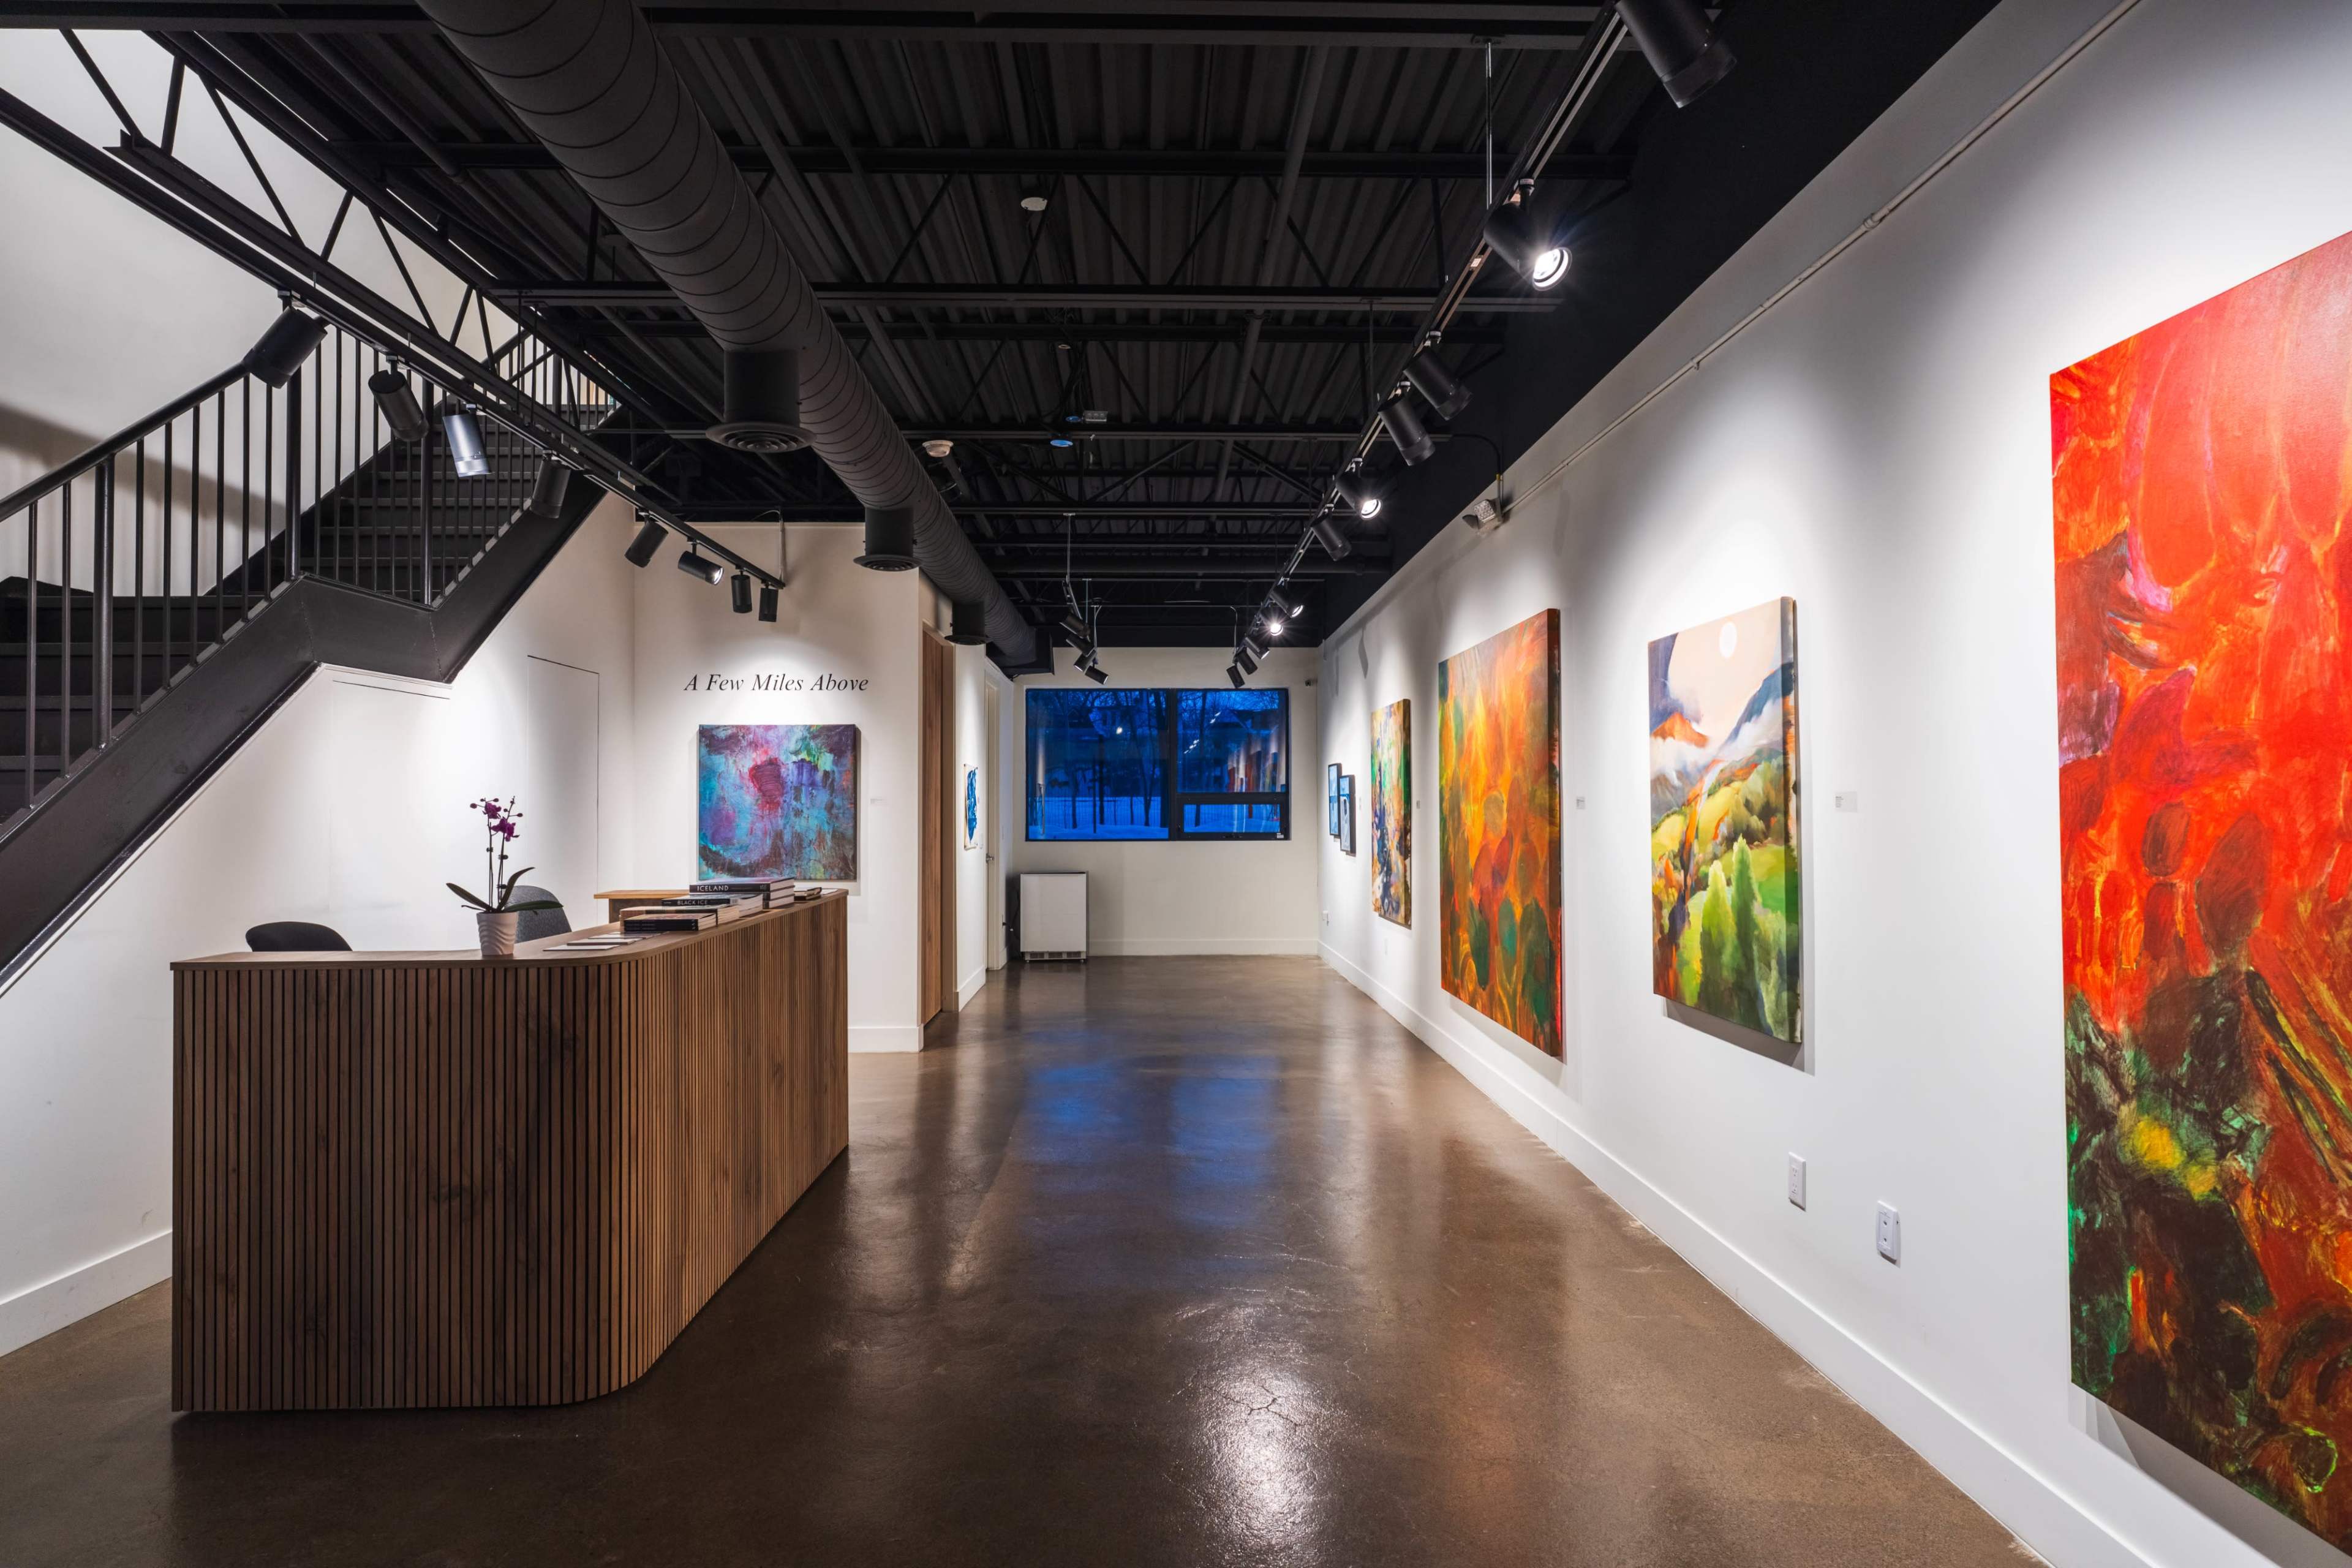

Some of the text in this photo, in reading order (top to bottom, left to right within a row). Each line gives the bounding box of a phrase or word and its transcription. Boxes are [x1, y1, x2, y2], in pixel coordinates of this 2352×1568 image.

[684, 674, 869, 691] A Few Miles Above
